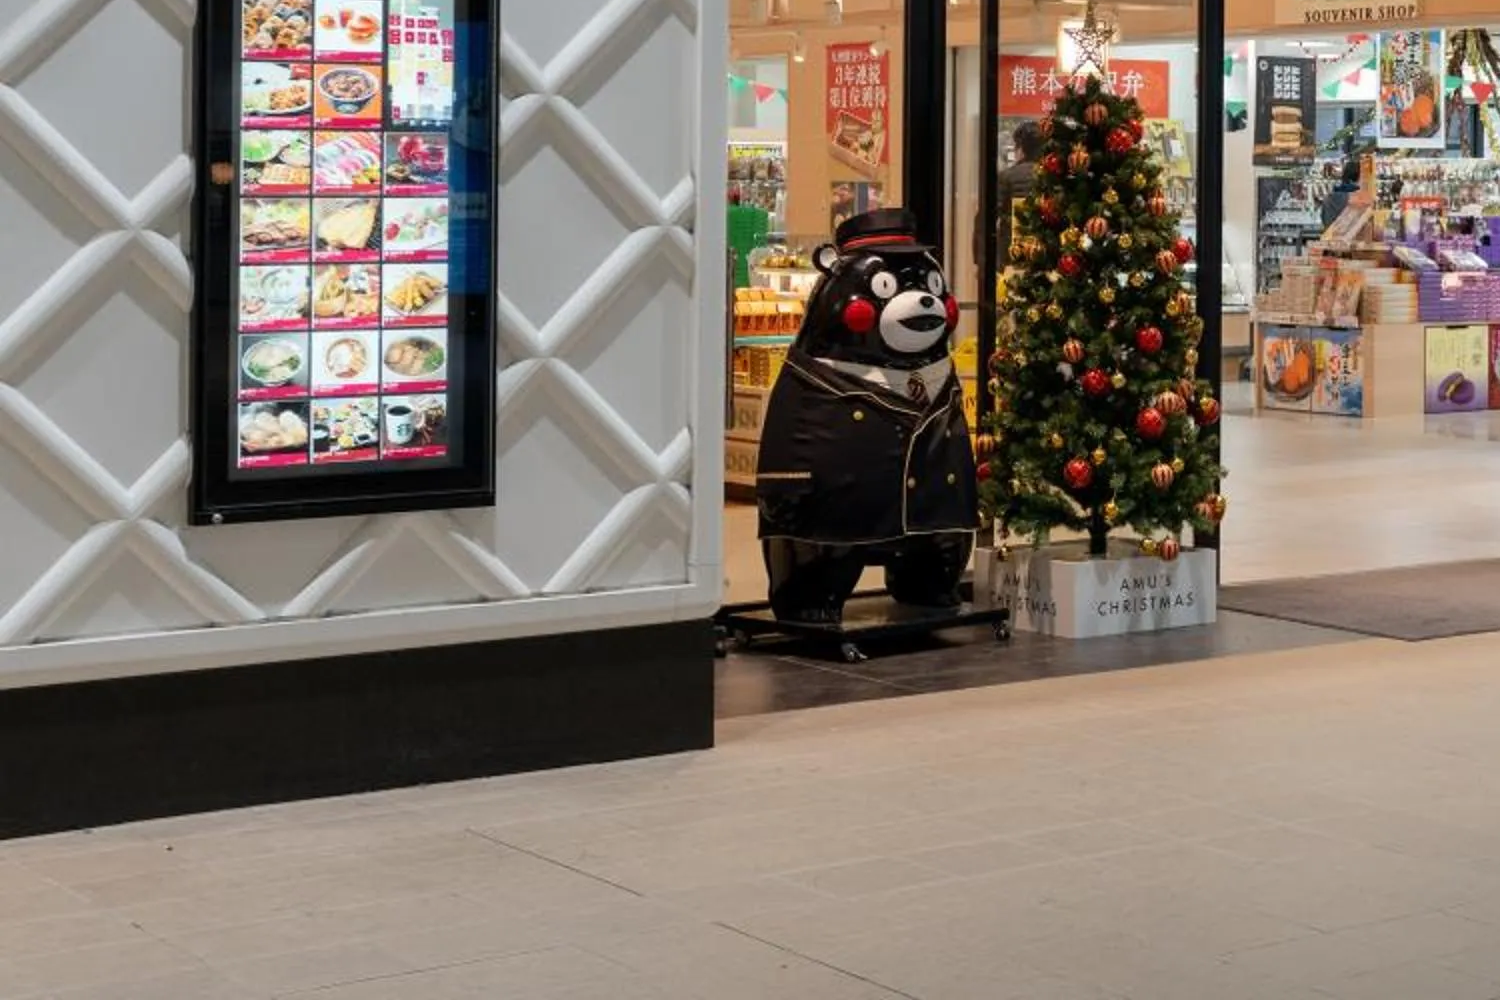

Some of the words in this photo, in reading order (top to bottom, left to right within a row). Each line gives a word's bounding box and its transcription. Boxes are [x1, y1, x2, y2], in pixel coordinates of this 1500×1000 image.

[1304, 8, 1375, 24] SOUVENIR
[1377, 5, 1416, 21] SHOP
[1119, 574, 1172, 592] AMU'S
[1097, 591, 1194, 617] CHRISTMAS
